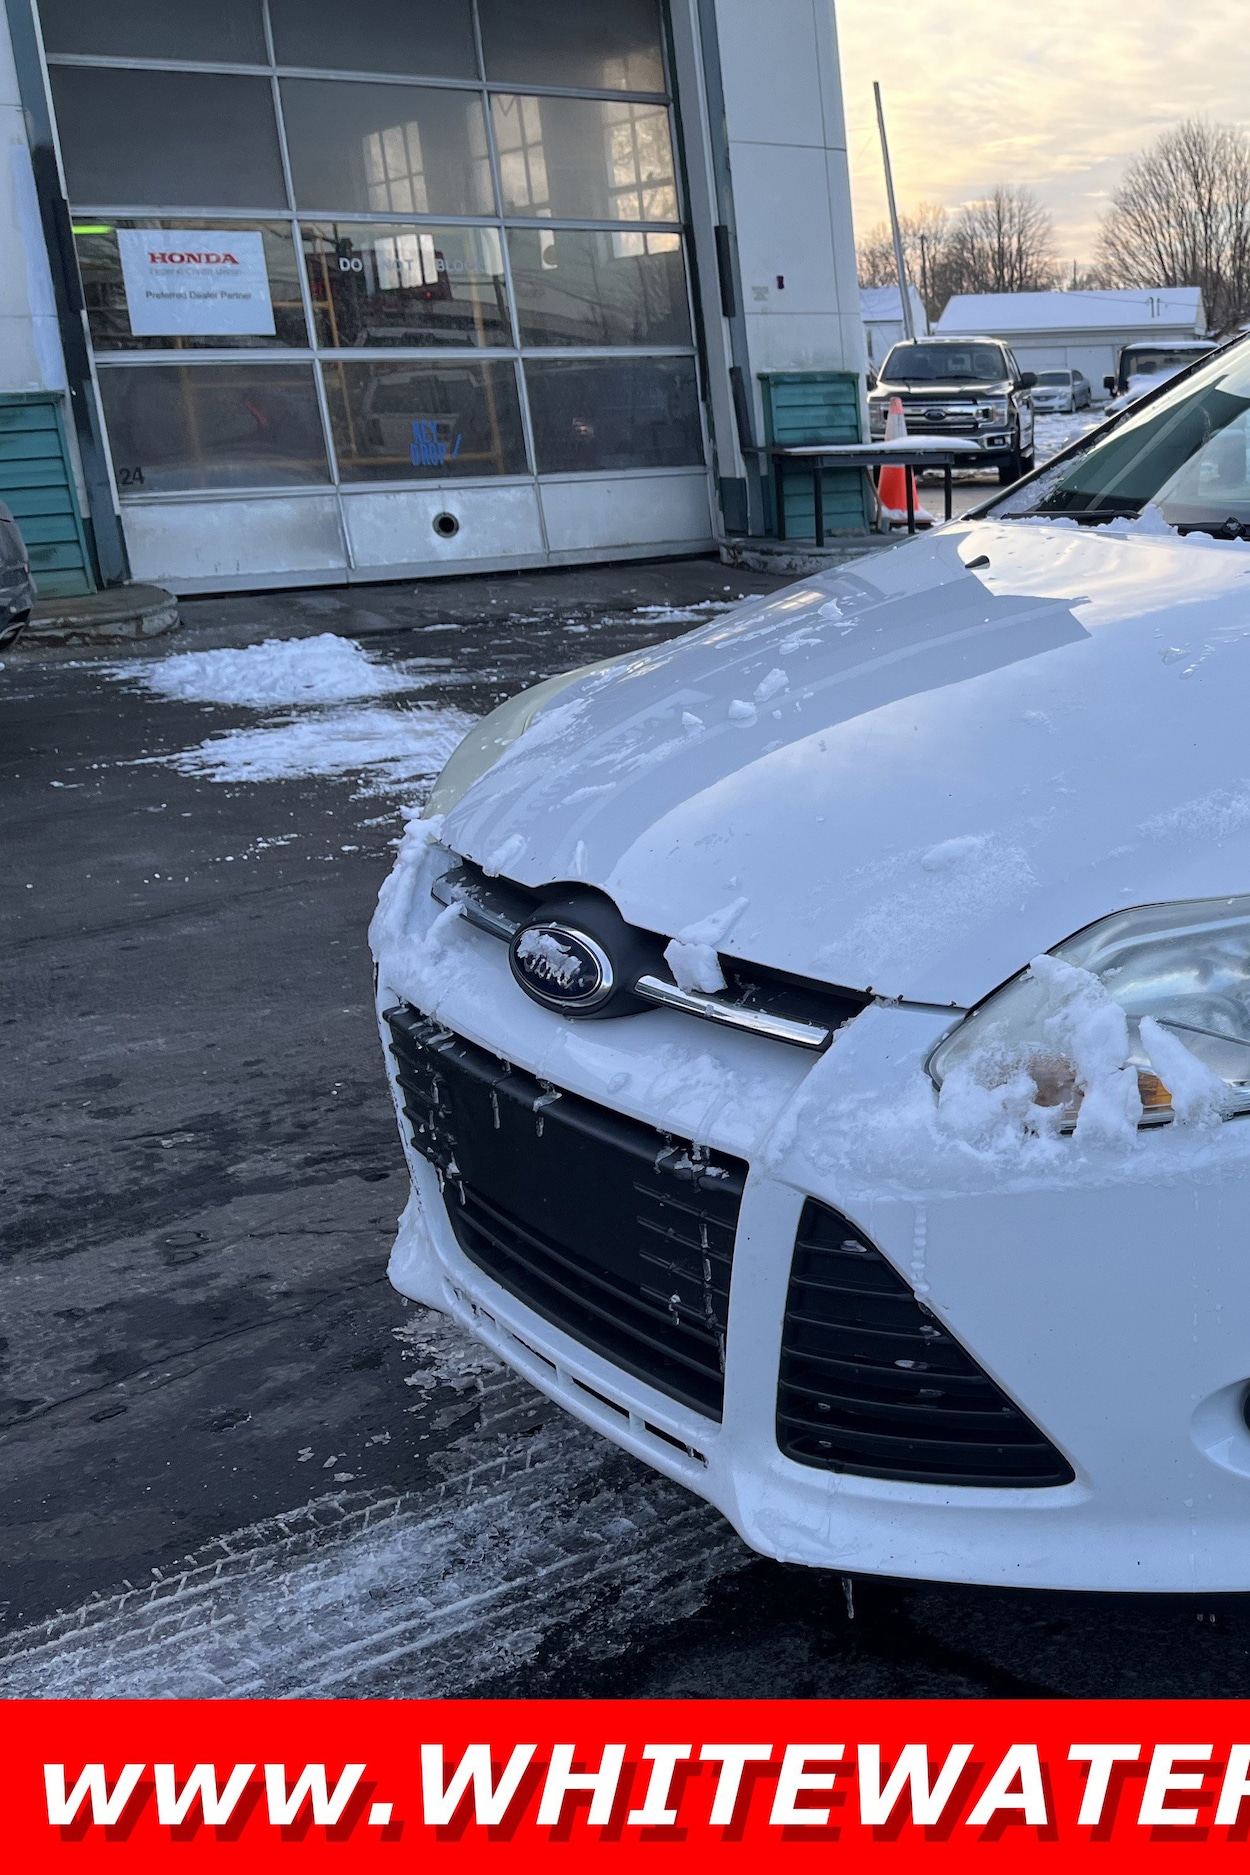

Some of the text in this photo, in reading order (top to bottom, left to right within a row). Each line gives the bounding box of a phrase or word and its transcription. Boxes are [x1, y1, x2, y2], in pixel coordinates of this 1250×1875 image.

[148, 252, 239, 264] HONDA
[338, 256, 363, 272] DO
[146, 291, 187, 300] Preferred
[189, 291, 218, 299] Dealer
[411, 421, 438, 442] KEY
[410, 442, 446, 466] DROP
[119, 467, 145, 485] 24
